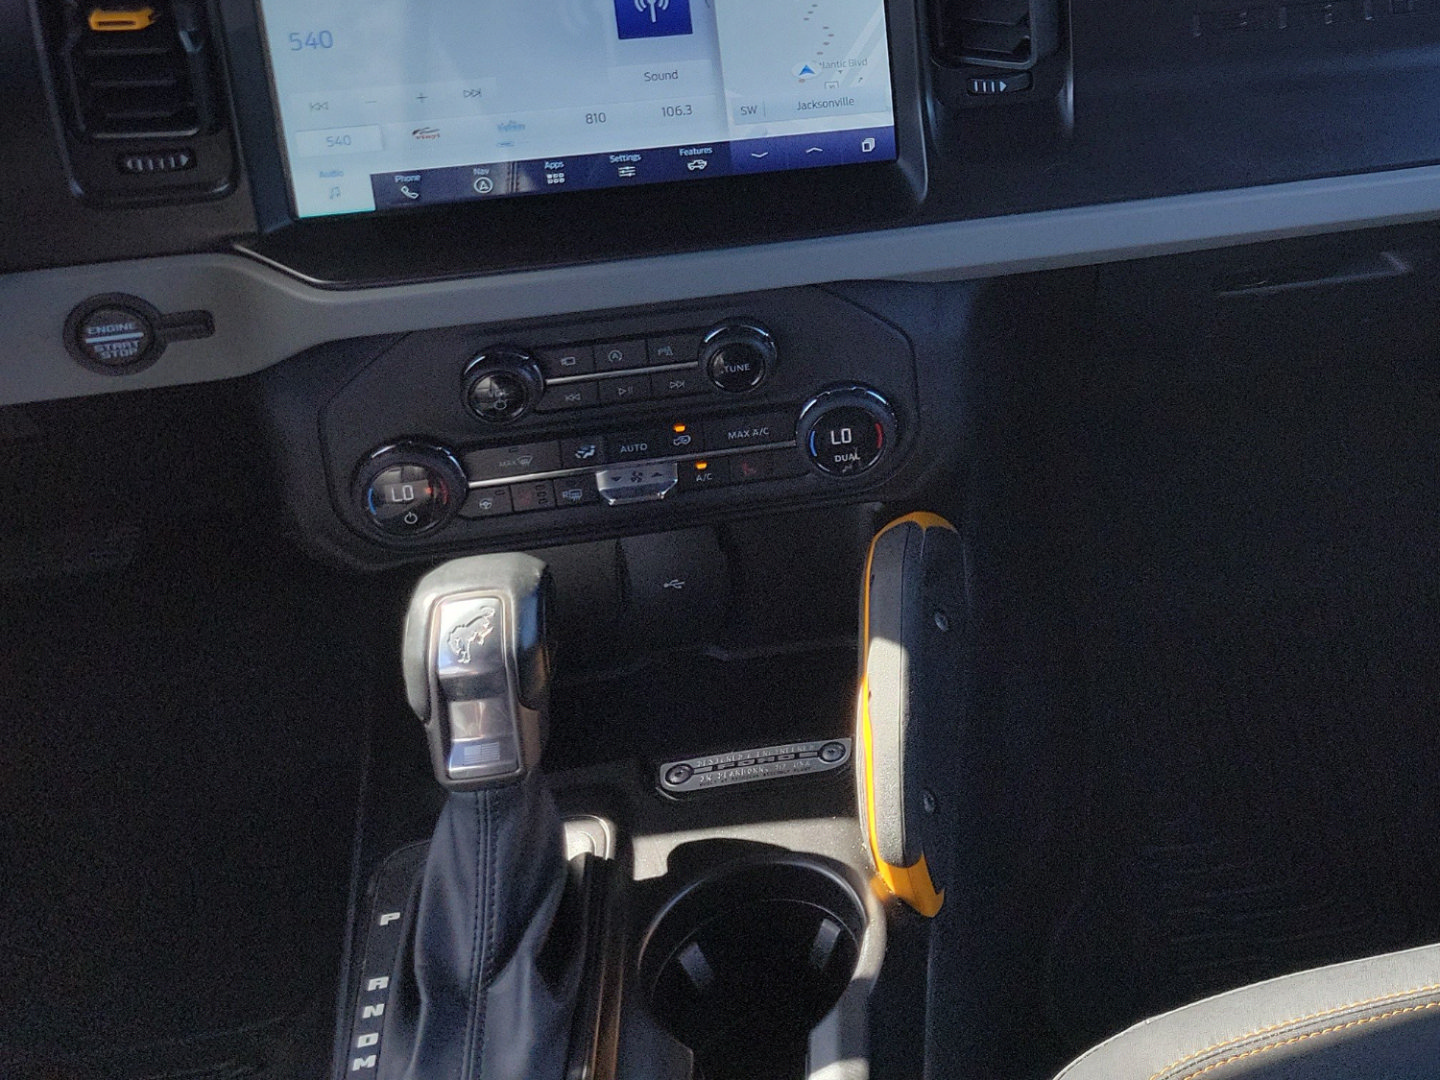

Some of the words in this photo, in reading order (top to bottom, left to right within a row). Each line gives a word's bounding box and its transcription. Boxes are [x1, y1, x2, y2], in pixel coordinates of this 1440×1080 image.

[288, 29, 334, 52] 540
[643, 70, 679, 82] Sound
[661, 104, 693, 118] 106.3
[740, 105, 758, 117] SW
[796, 96, 855, 113] Jacksonville
[585, 112, 607, 125] 810
[326, 134, 352, 148] 540
[679, 146, 713, 157] Features
[544, 160, 565, 171] Apps
[609, 153, 642, 165] Settings
[394, 174, 421, 183] Phone
[86, 322, 137, 335] ENGINE
[100, 348, 138, 359] STOP
[723, 363, 751, 374] TUNE
[728, 431, 750, 440] MAX
[751, 427, 770, 437] A/C
[830, 427, 852, 445] LO
[620, 442, 648, 454] AUTO
[834, 452, 861, 463] DUAL
[695, 472, 713, 482] A/C
[391, 484, 415, 502] LO
[379, 912, 401, 926] P
[362, 1003, 385, 1018] N
[356, 1032, 379, 1048] D
[351, 1054, 376, 1071] M
